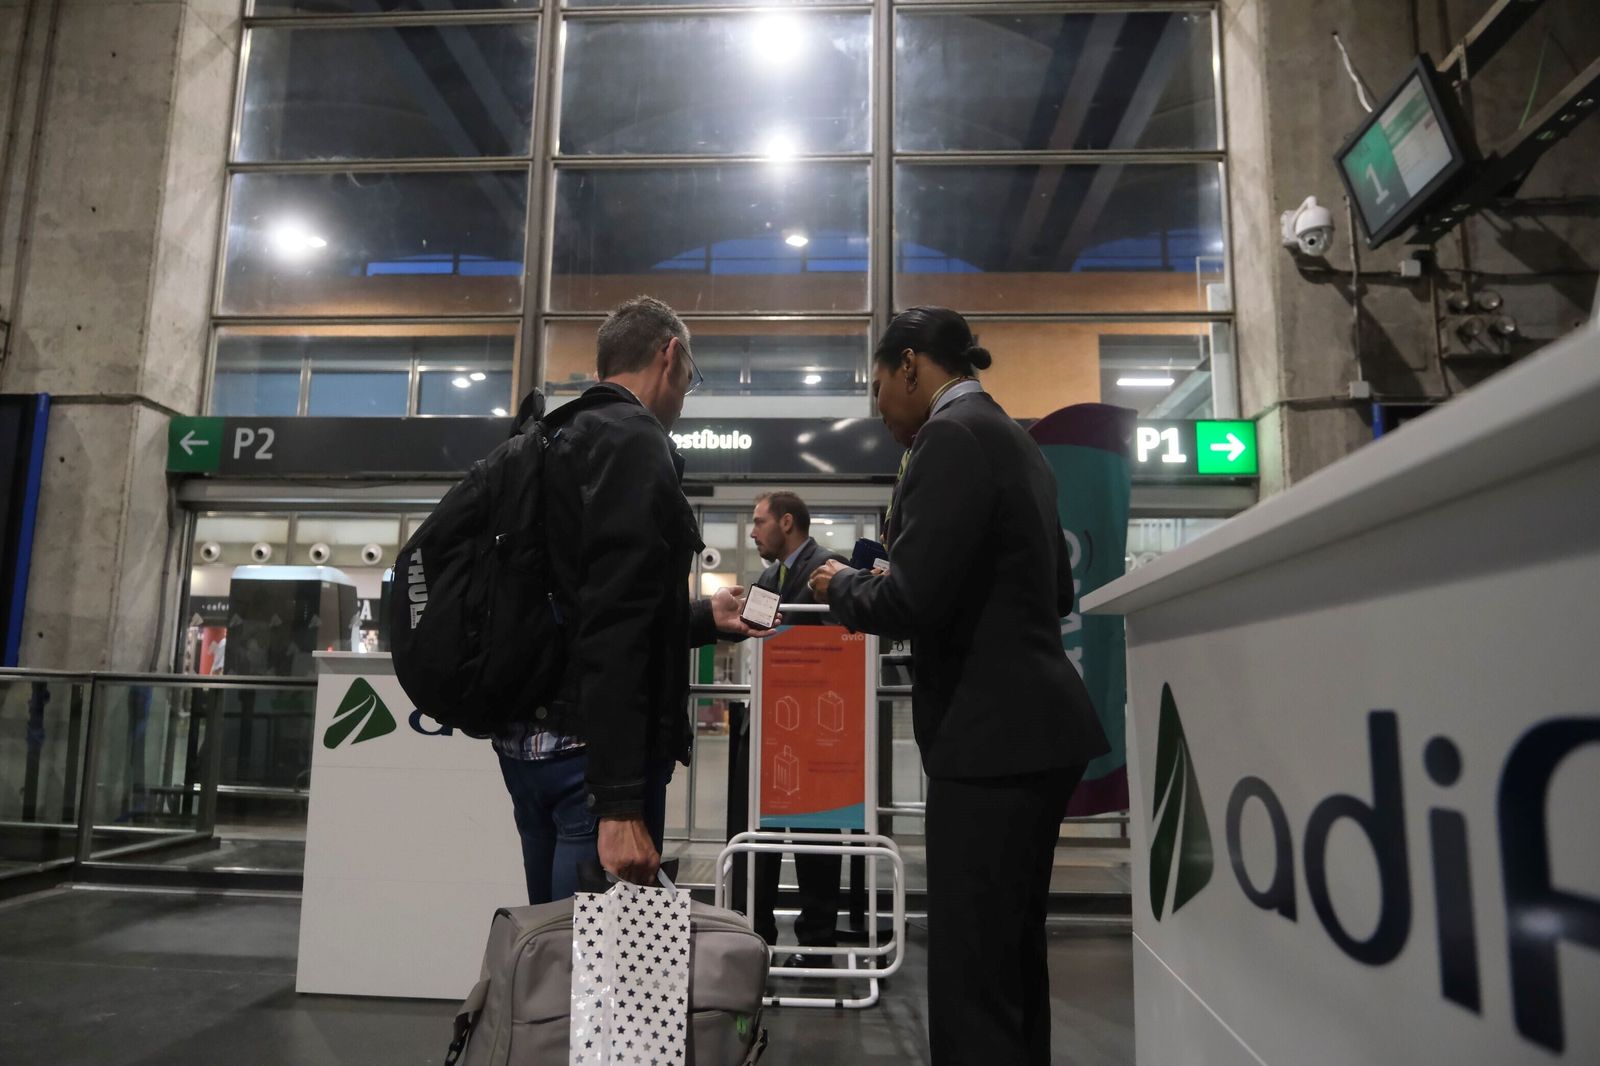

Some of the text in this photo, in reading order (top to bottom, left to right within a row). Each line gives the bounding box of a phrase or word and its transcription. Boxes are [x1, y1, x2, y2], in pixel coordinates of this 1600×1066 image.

[1366, 163, 1390, 205] 1
[233, 427, 275, 459] P2
[668, 429, 752, 449] estíbulo
[1136, 427, 1187, 462] P1
